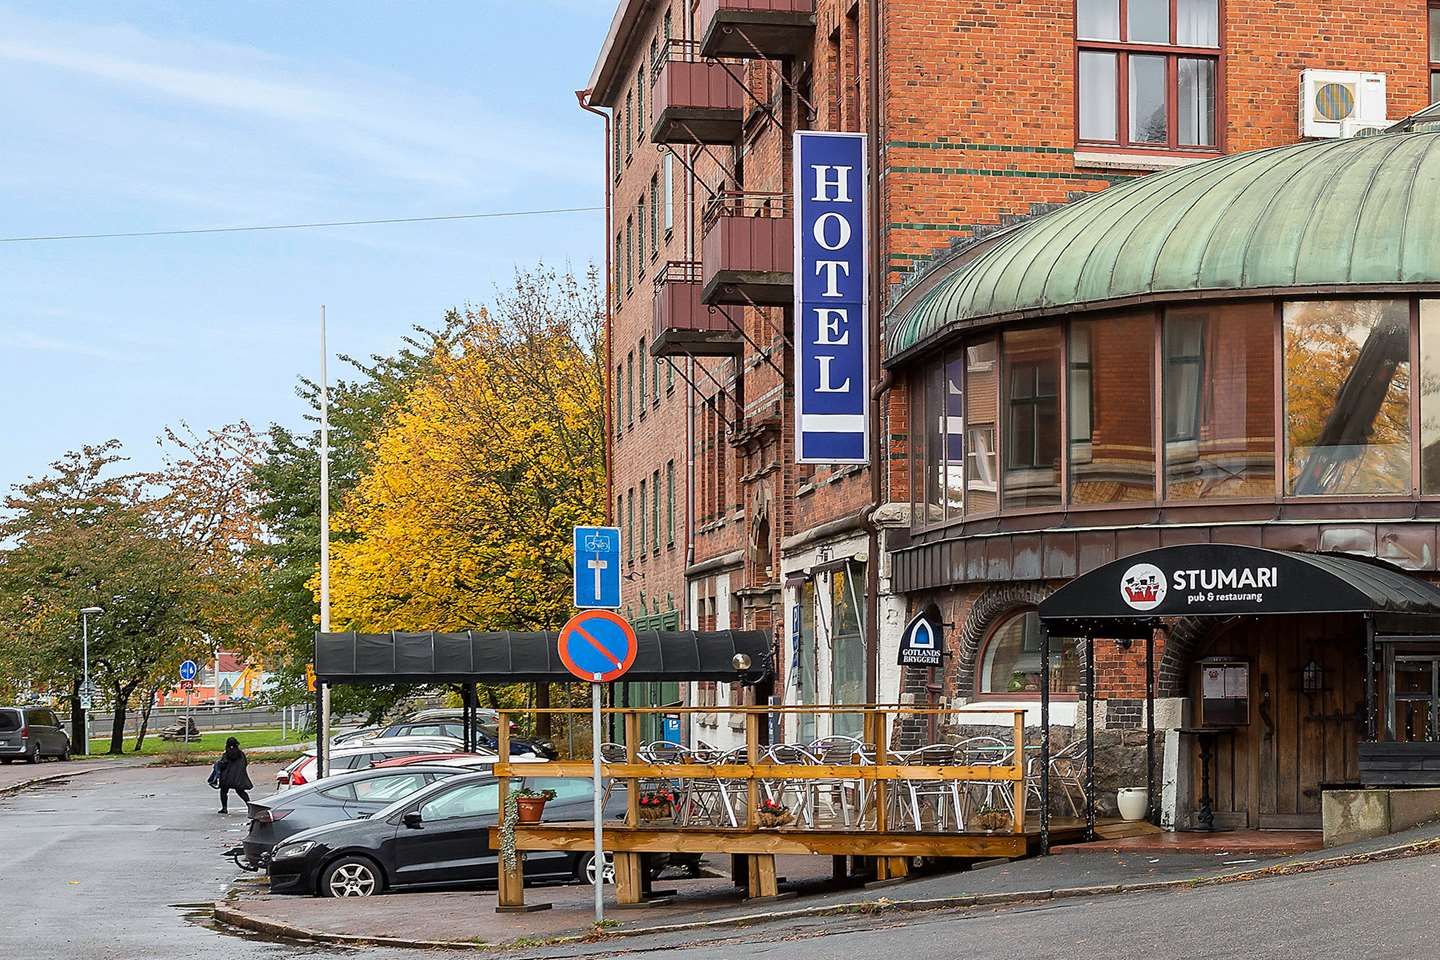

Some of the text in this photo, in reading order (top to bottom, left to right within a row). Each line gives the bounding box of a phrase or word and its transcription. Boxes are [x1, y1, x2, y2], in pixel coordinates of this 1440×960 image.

[811, 164, 853, 393] HOTEL
[1172, 566, 1278, 591] STUMARI
[1187, 591, 1263, 605] pub & restaurang
[902, 648, 941, 657] GOTLANDS
[903, 656, 939, 664] BRYGGERI
